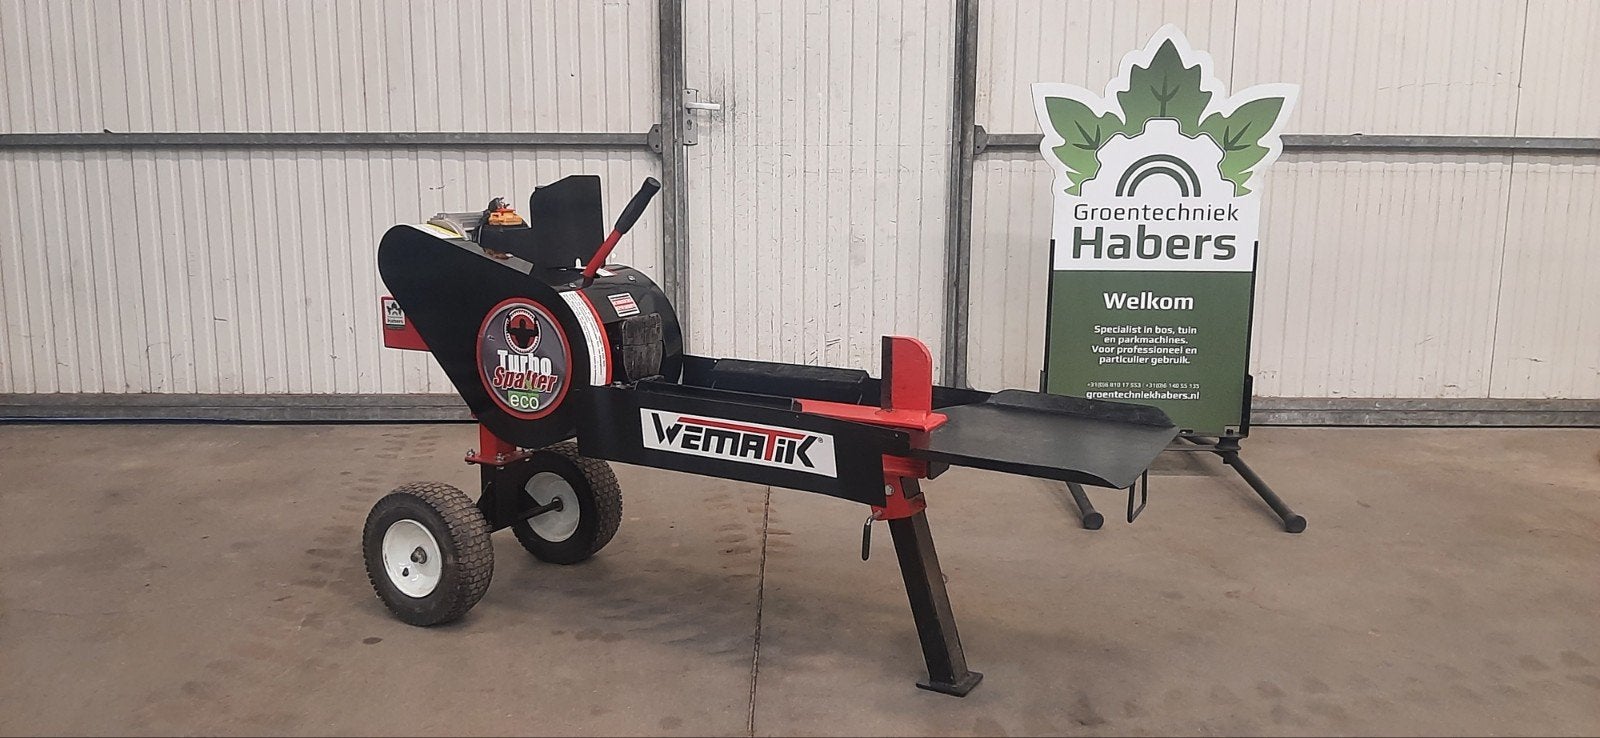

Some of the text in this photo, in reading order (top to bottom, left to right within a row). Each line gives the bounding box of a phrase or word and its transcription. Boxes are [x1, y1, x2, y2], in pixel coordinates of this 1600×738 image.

[1074, 204, 1239, 221] Groentechniek
[1072, 225, 1237, 260] Habers
[1103, 291, 1194, 310] Welkom
[1094, 325, 1142, 335] Specialist
[1143, 326, 1153, 334] in
[1155, 326, 1175, 335] bos,
[1118, 336, 1188, 345] parkmachines.
[1092, 346, 1197, 355] Voor professioneel en
[497, 349, 552, 375] Turbo
[1099, 356, 1190, 366] particulier gebruik.
[493, 366, 558, 393] Spalter
[509, 394, 540, 410] eco
[1086, 390, 1200, 400] groentechniekhabers.nl
